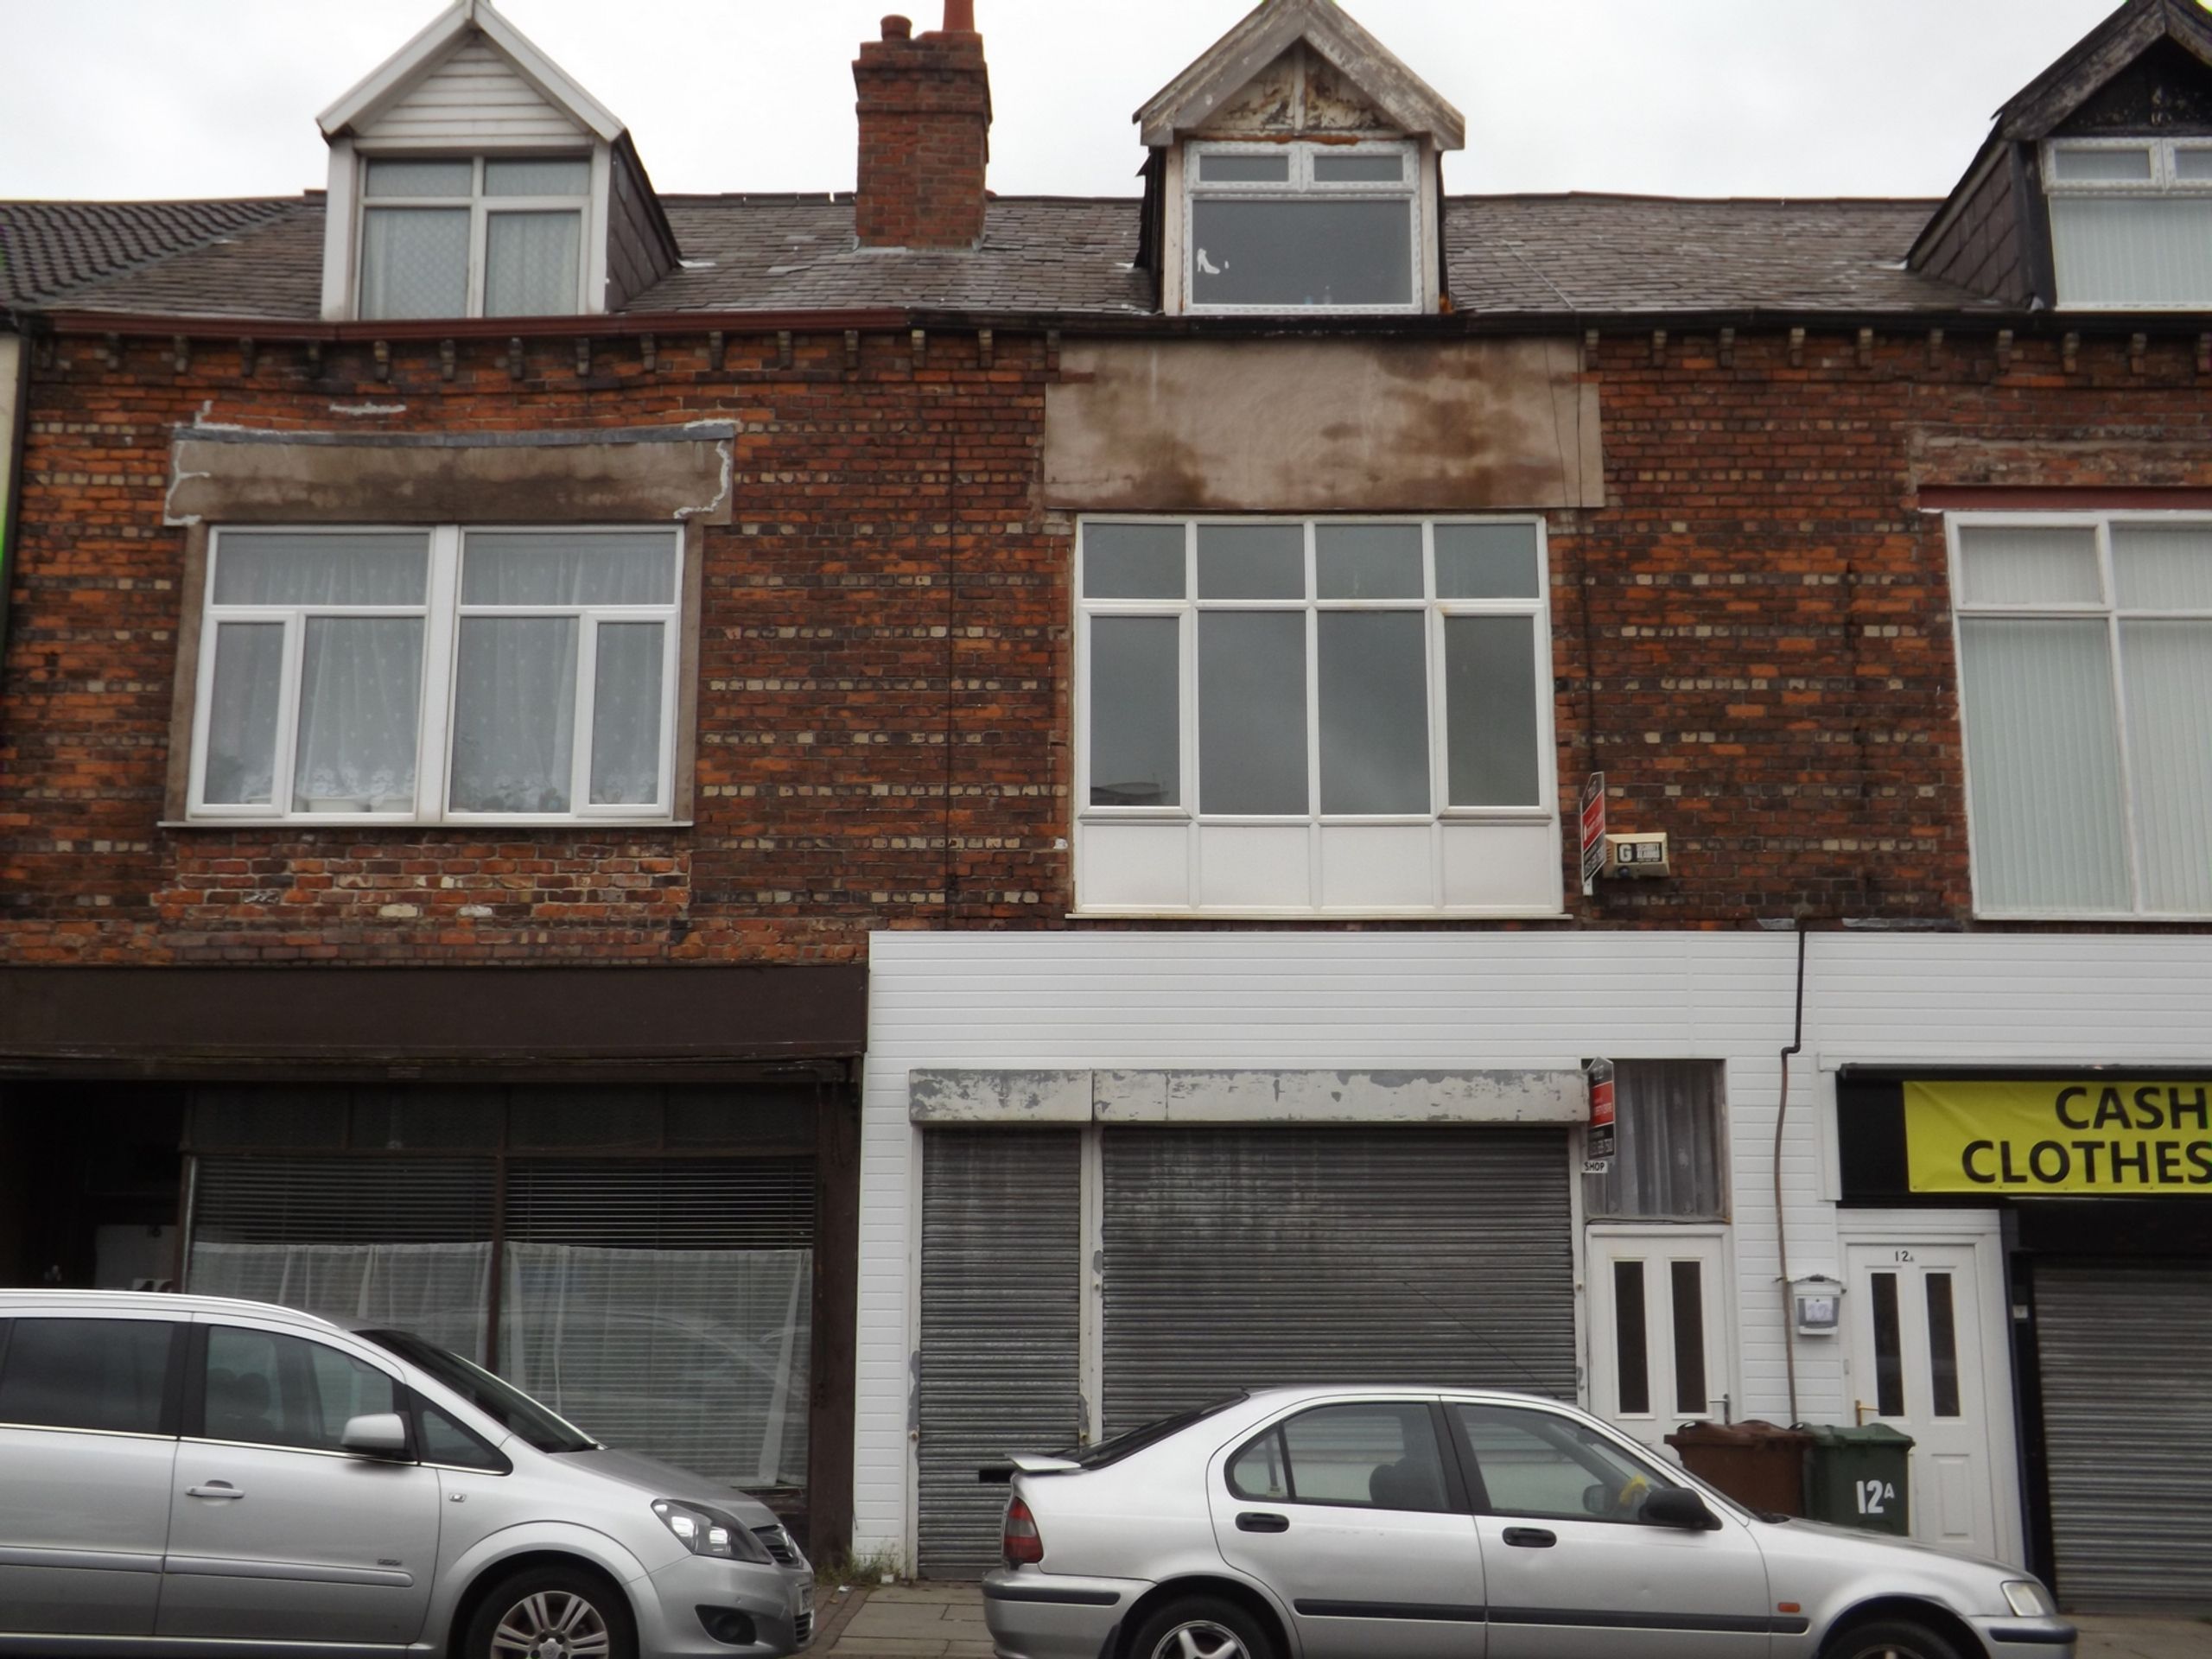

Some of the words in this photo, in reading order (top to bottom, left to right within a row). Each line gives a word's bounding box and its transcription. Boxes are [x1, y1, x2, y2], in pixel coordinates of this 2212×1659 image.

[1619, 843, 1632, 862] G
[2055, 1086, 2209, 1130] CASH
[1584, 1160, 1605, 1173] SHOP
[1961, 1140, 2212, 1184] CLOTHES
[1856, 1479, 1895, 1514] 12A
